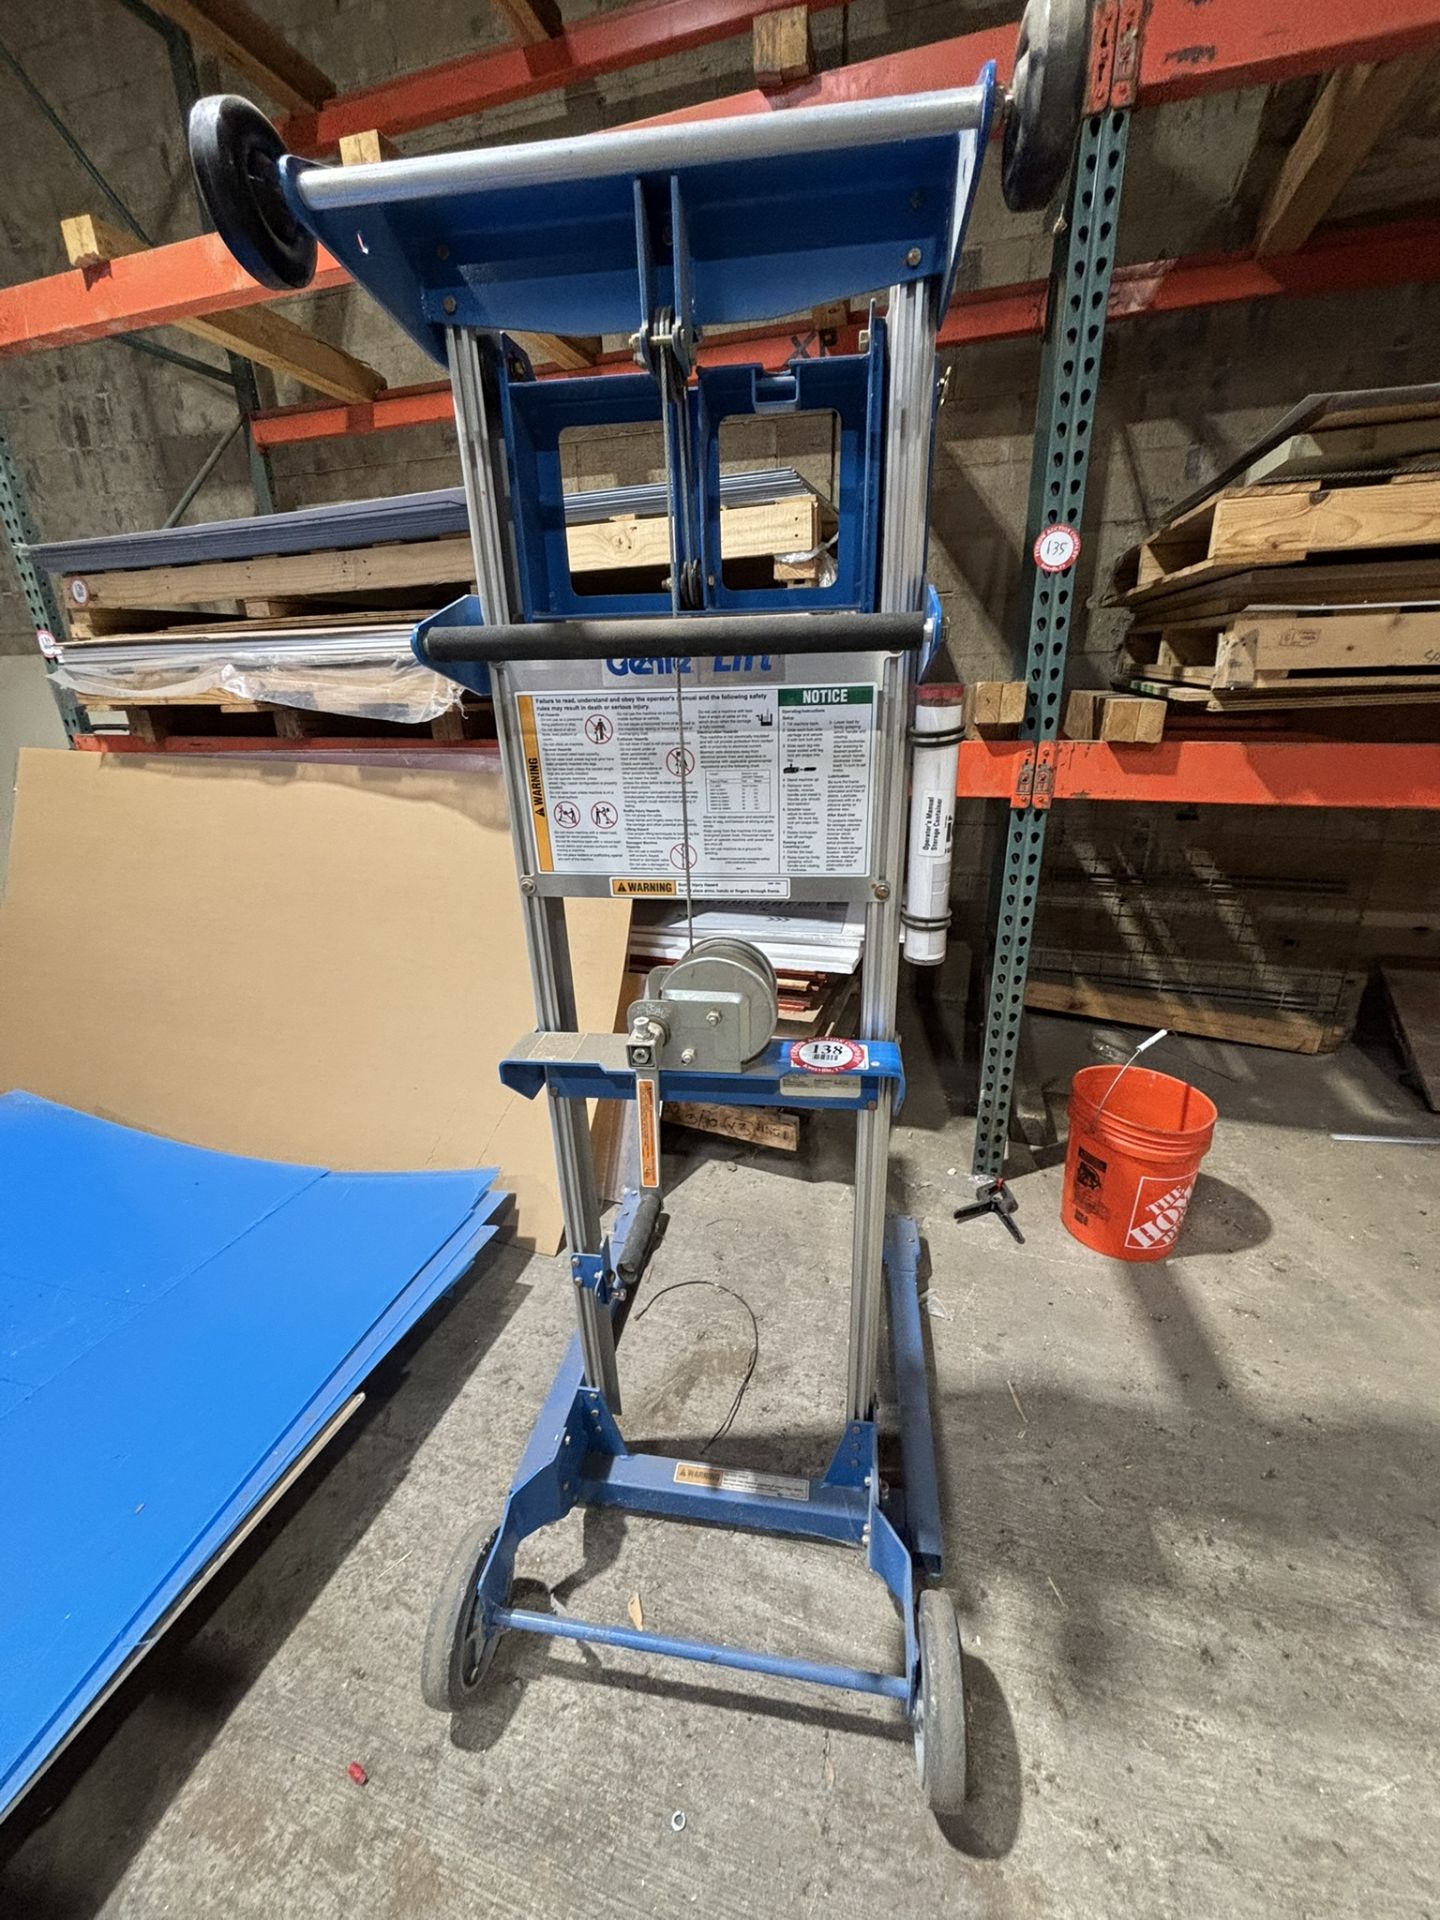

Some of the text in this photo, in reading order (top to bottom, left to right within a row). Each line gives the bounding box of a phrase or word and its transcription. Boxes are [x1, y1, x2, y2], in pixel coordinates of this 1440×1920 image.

[1046, 540, 1069, 555] 135
[802, 689, 848, 703] NOTICE
[528, 757, 543, 806] WARNING
[923, 796, 934, 850] Operator's Manual
[931, 798, 942, 851] Storage Container
[627, 882, 672, 893] WARNING
[812, 1044, 843, 1055] 138
[1145, 1185, 1184, 1215] THE
